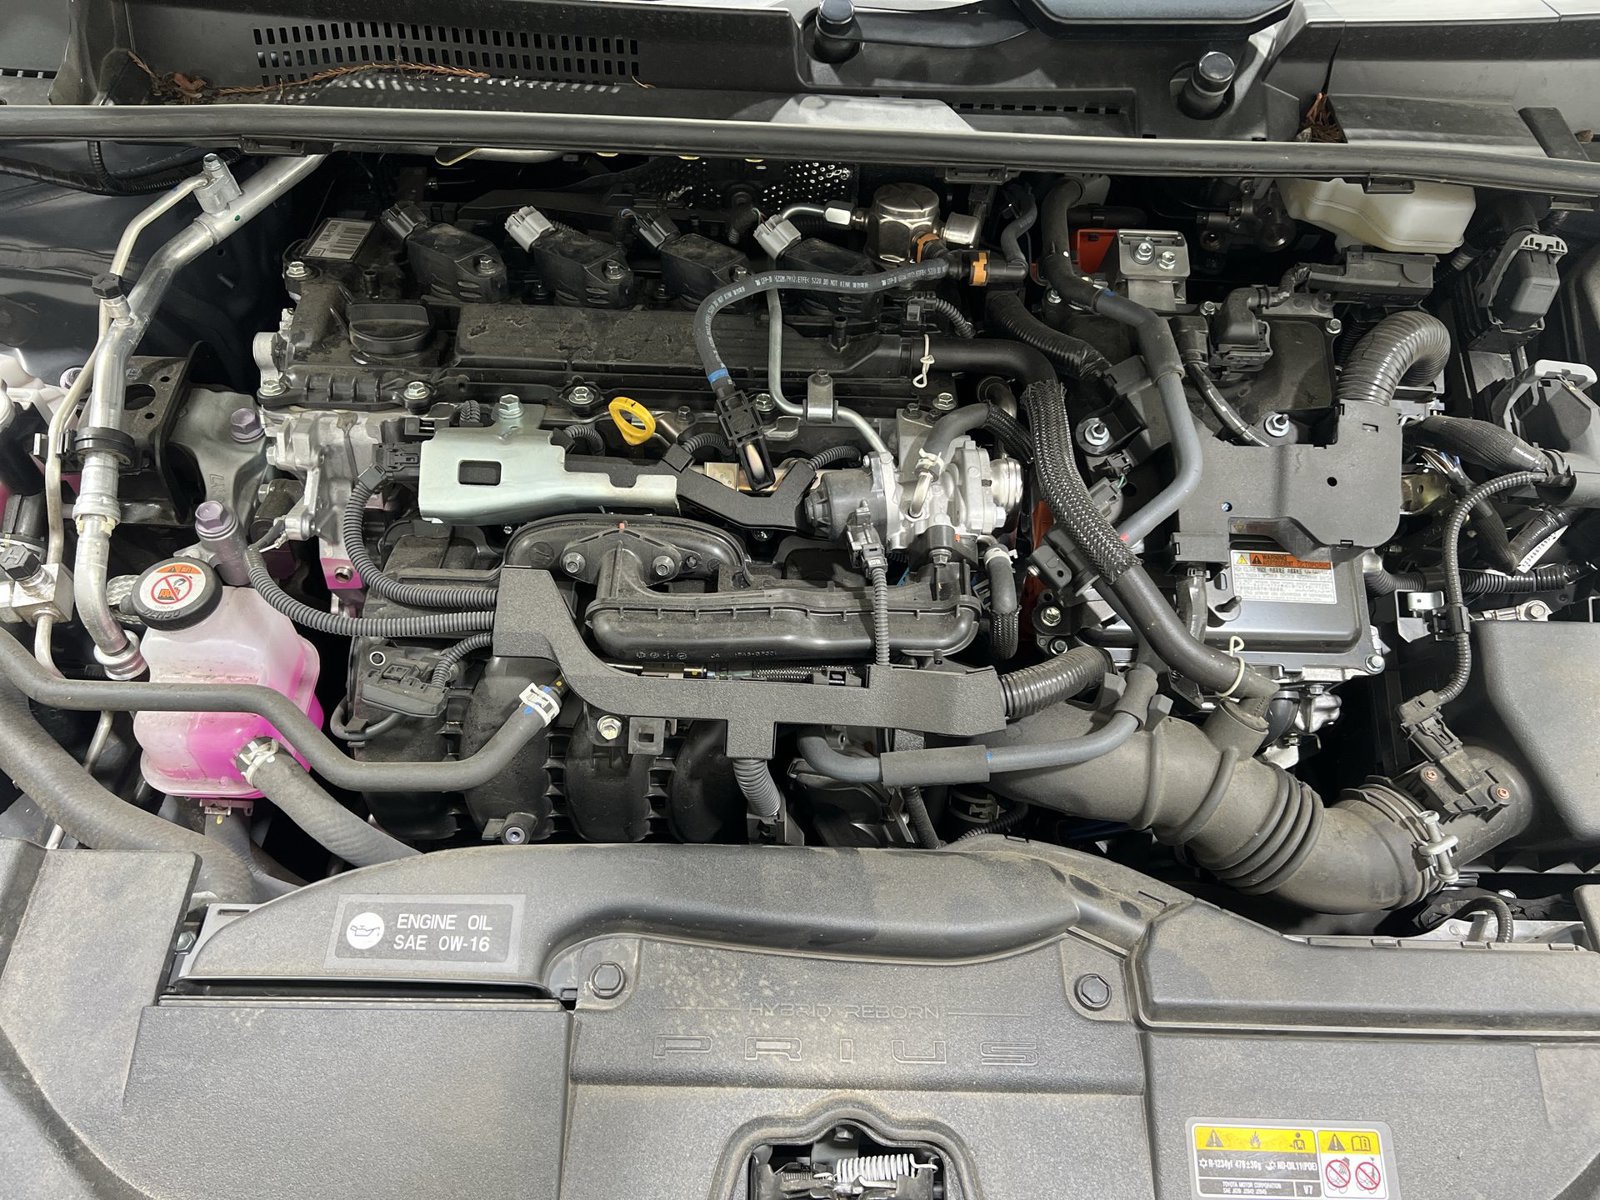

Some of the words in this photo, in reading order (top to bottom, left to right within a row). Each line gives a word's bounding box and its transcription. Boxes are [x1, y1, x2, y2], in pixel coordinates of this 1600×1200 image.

[142, 608, 181, 620] DENSO
[397, 913, 457, 930] ENGINE
[467, 915, 493, 931] OIL
[393, 935, 427, 950] SAE
[438, 935, 490, 952] 0W-16
[748, 1003, 831, 1018] HYBRID
[844, 1004, 939, 1020] REBORN
[653, 1035, 1039, 1066] PRIUS
[1303, 1185, 1313, 1195] V7
